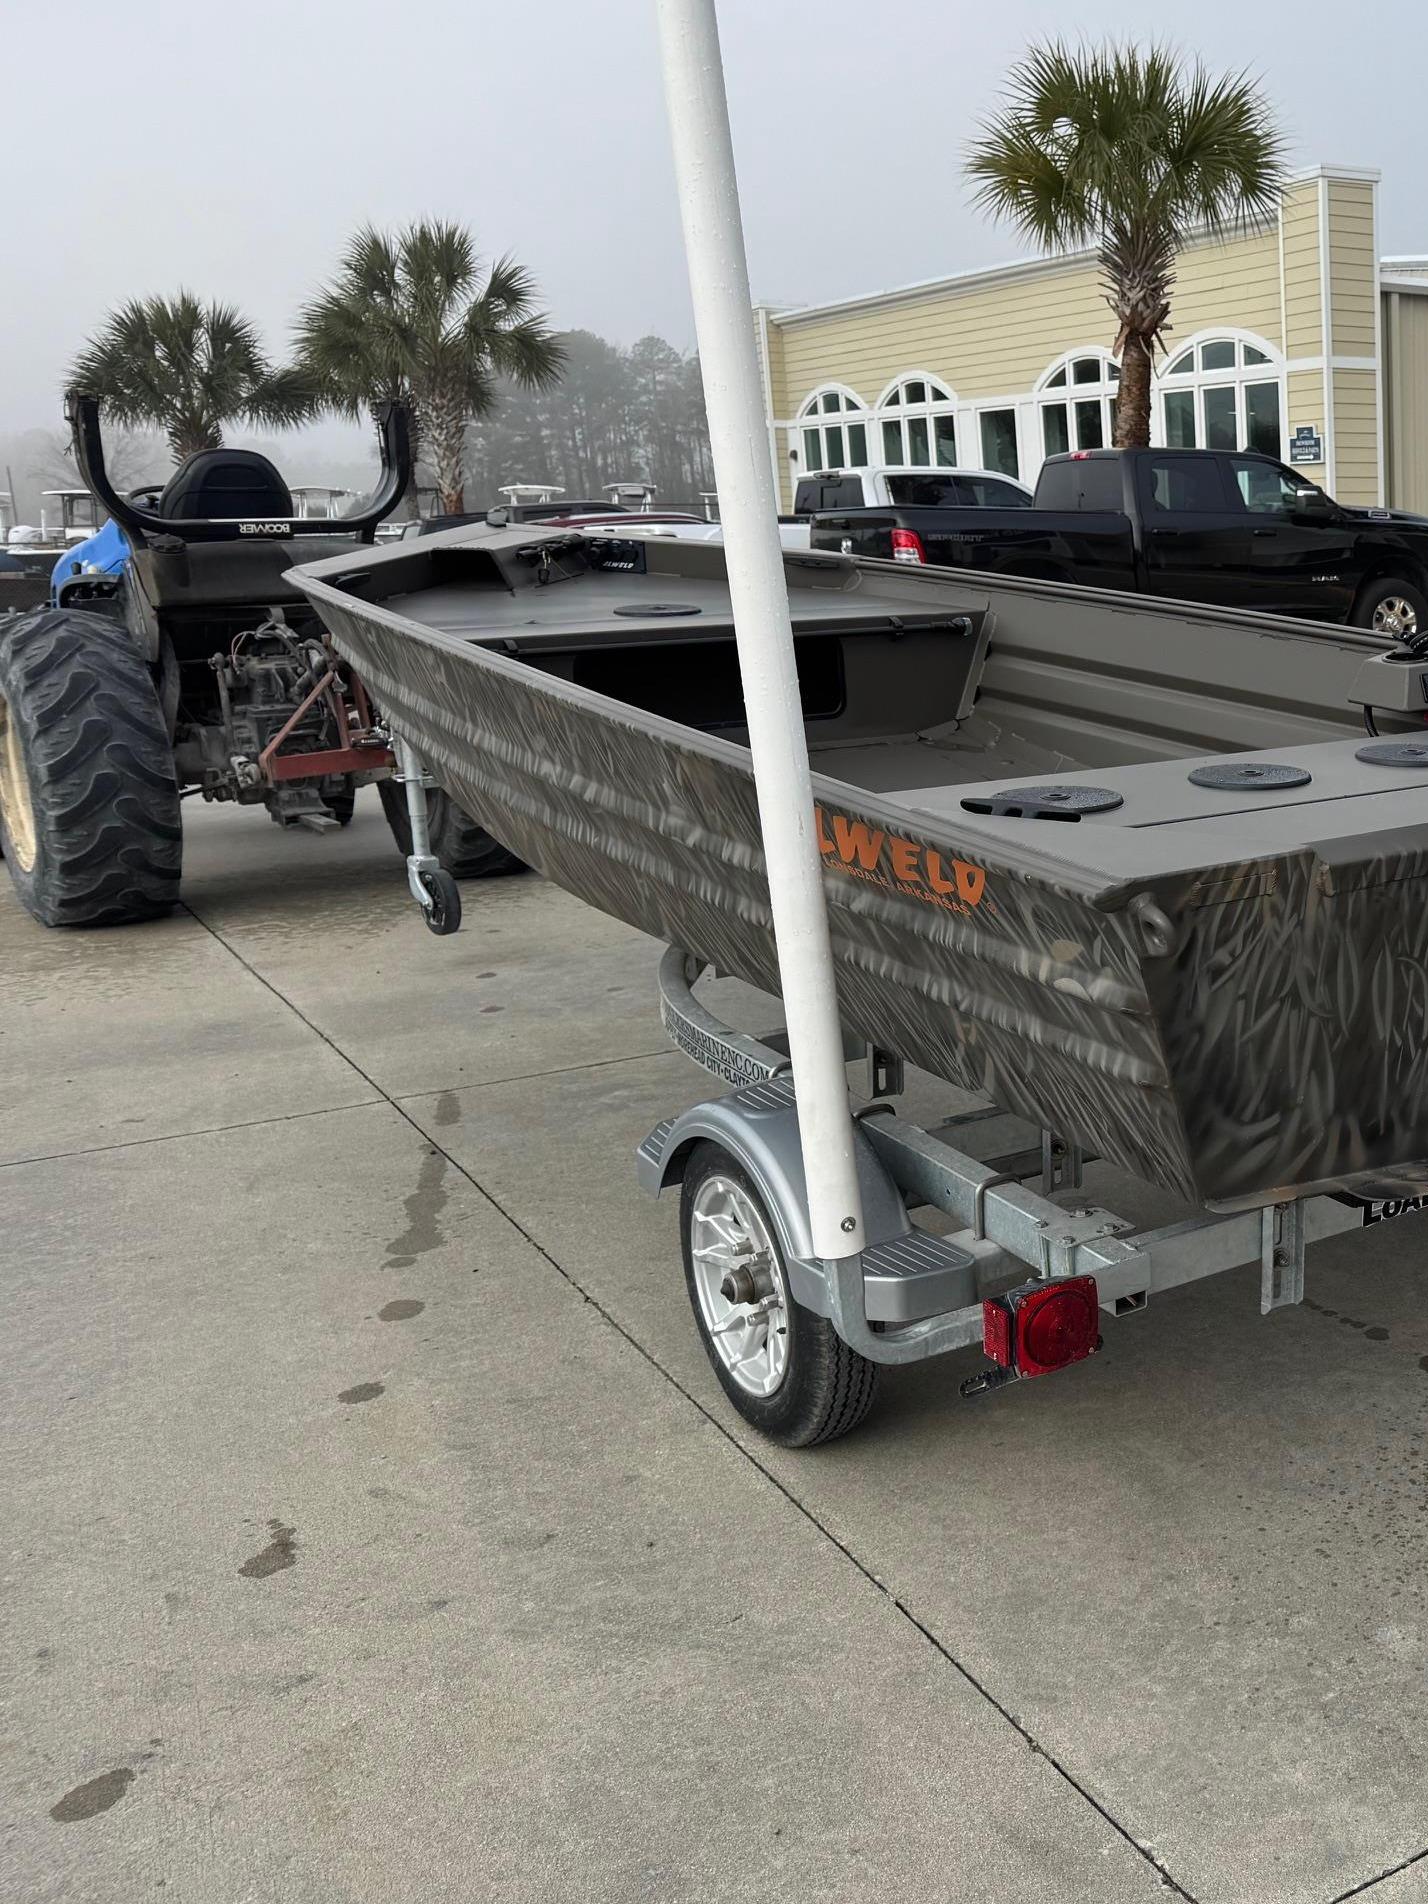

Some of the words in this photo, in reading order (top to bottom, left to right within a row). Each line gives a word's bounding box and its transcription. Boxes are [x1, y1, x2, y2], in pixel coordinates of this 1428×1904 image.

[239, 523, 290, 533] BOOMER
[814, 806, 985, 906] LWELD
[896, 882, 971, 917] ARKANSAS
